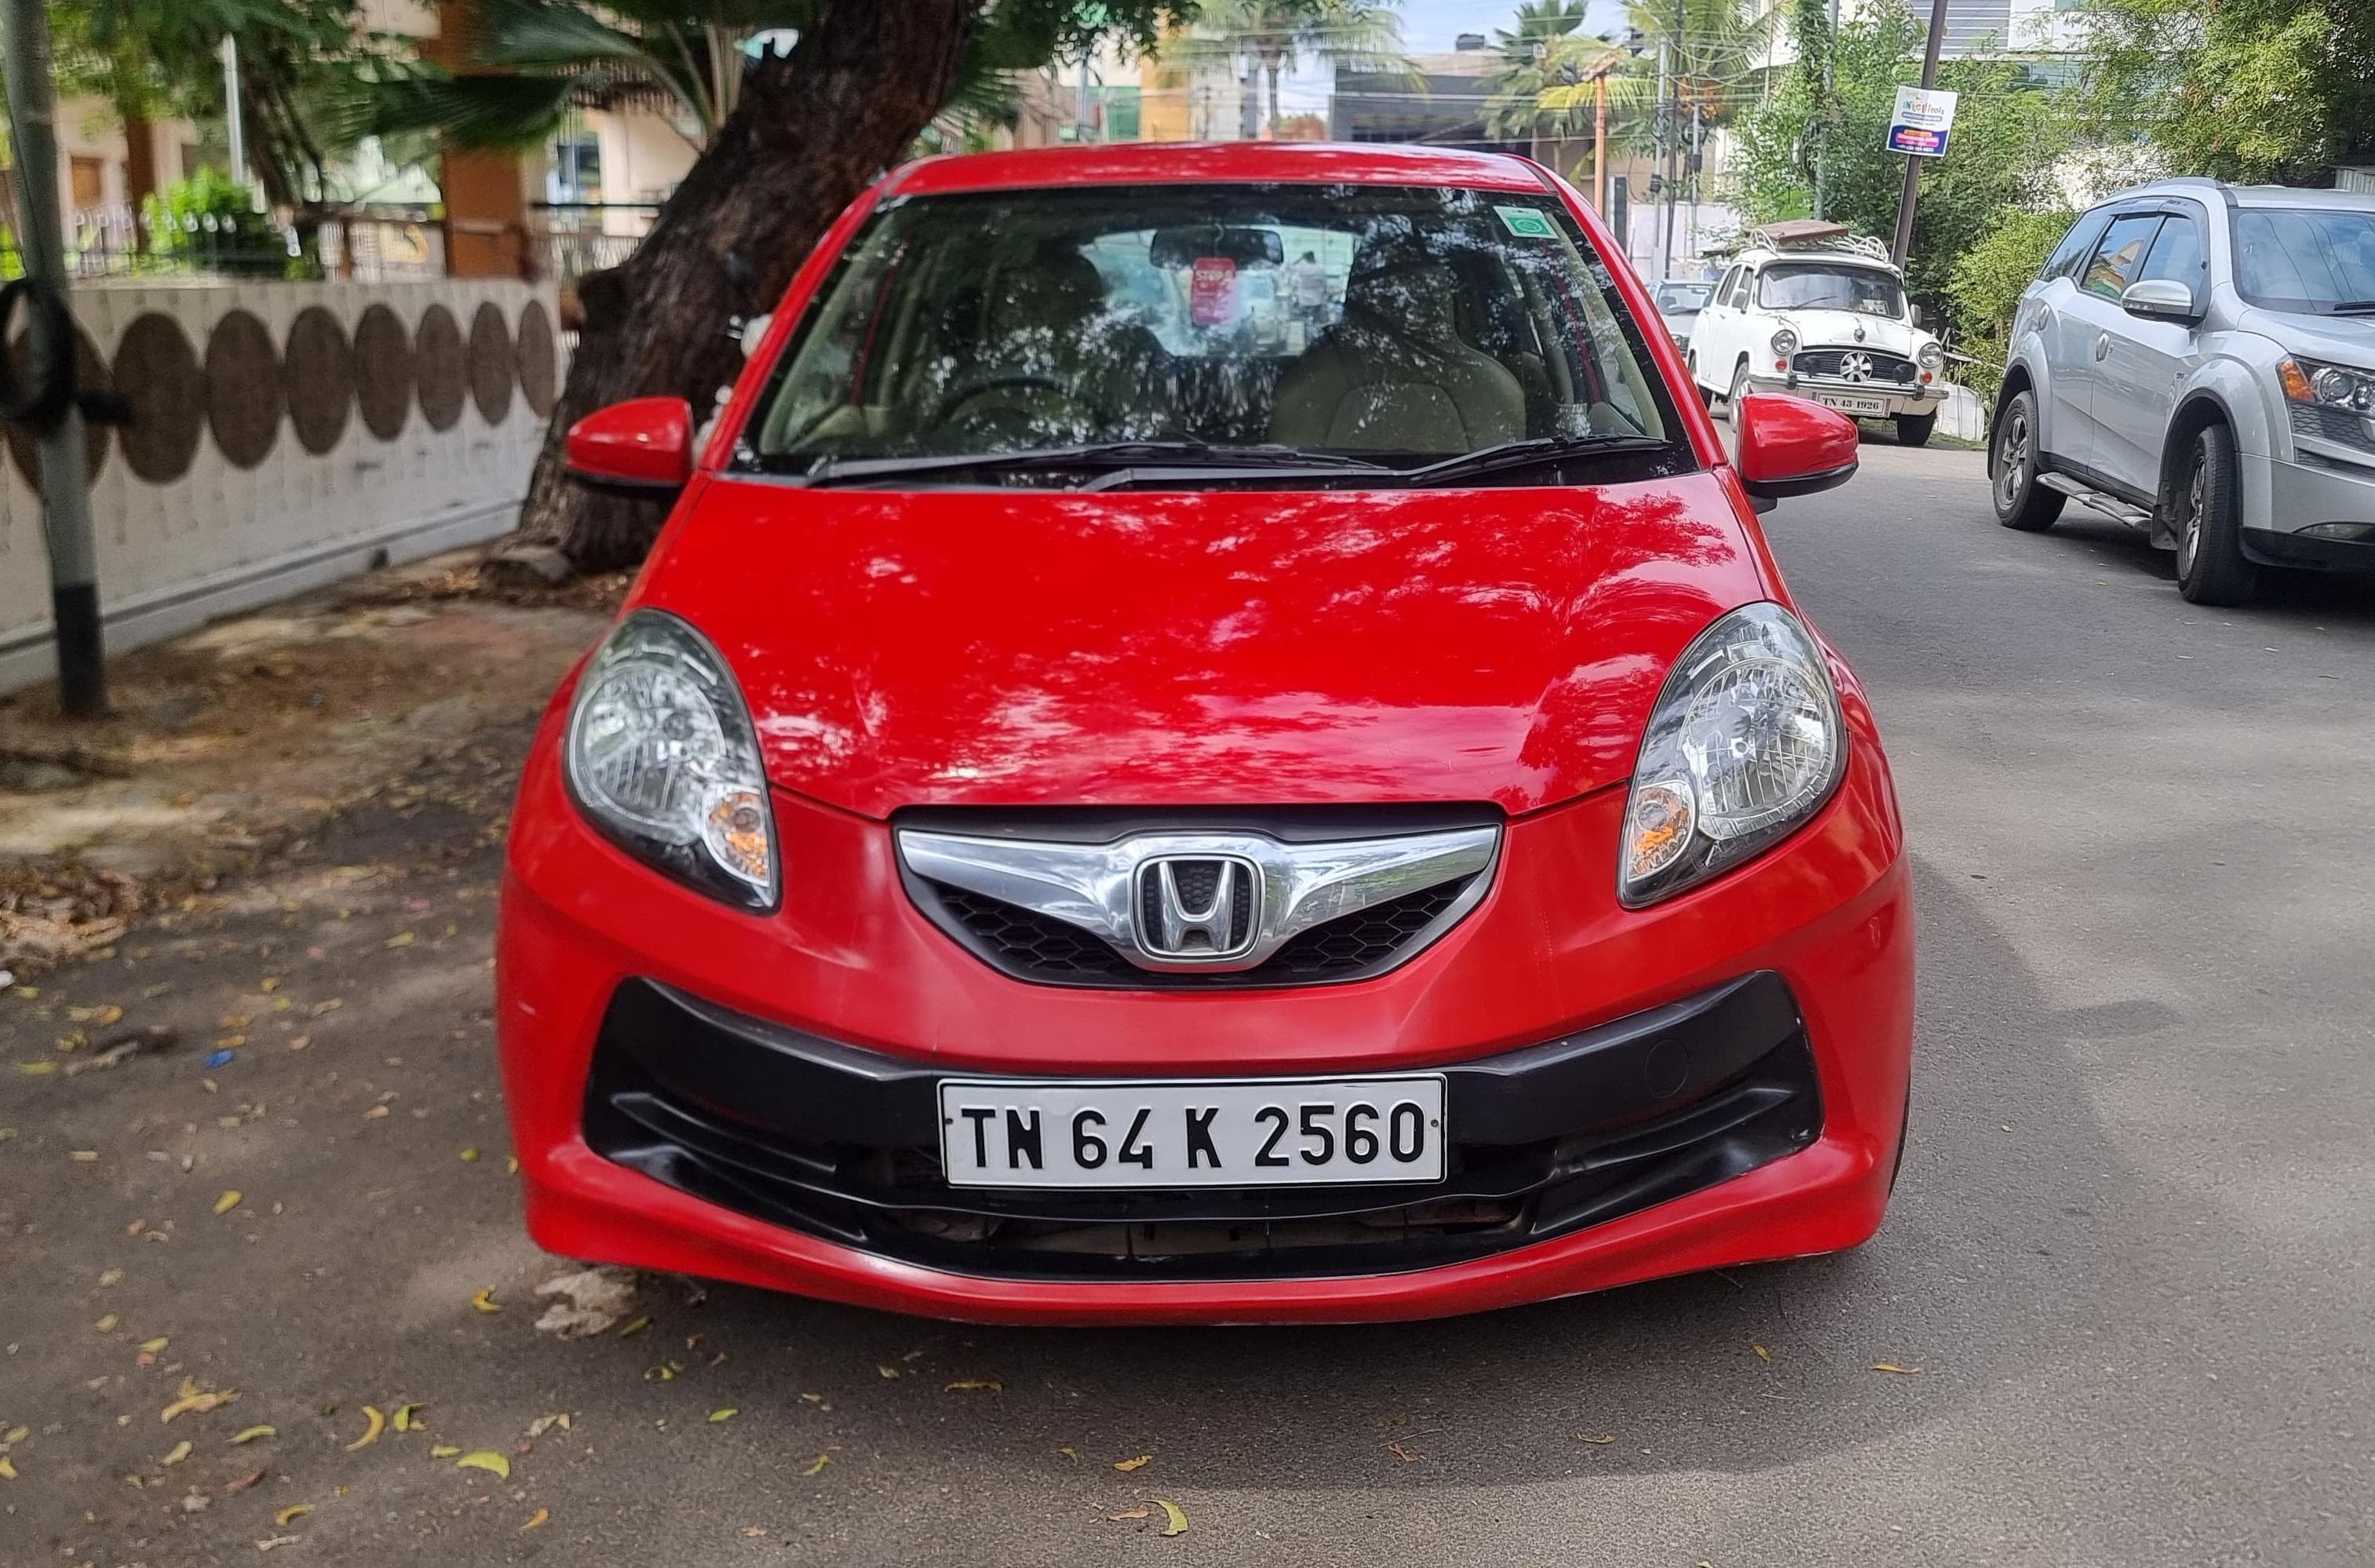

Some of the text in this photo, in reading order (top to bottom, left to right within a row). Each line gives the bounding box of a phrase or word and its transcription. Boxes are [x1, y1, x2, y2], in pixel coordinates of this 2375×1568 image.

[1822, 397, 1837, 407] TN
[1856, 400, 1880, 410] 1926
[961, 1102, 1425, 1169] TN 64 K 2560
